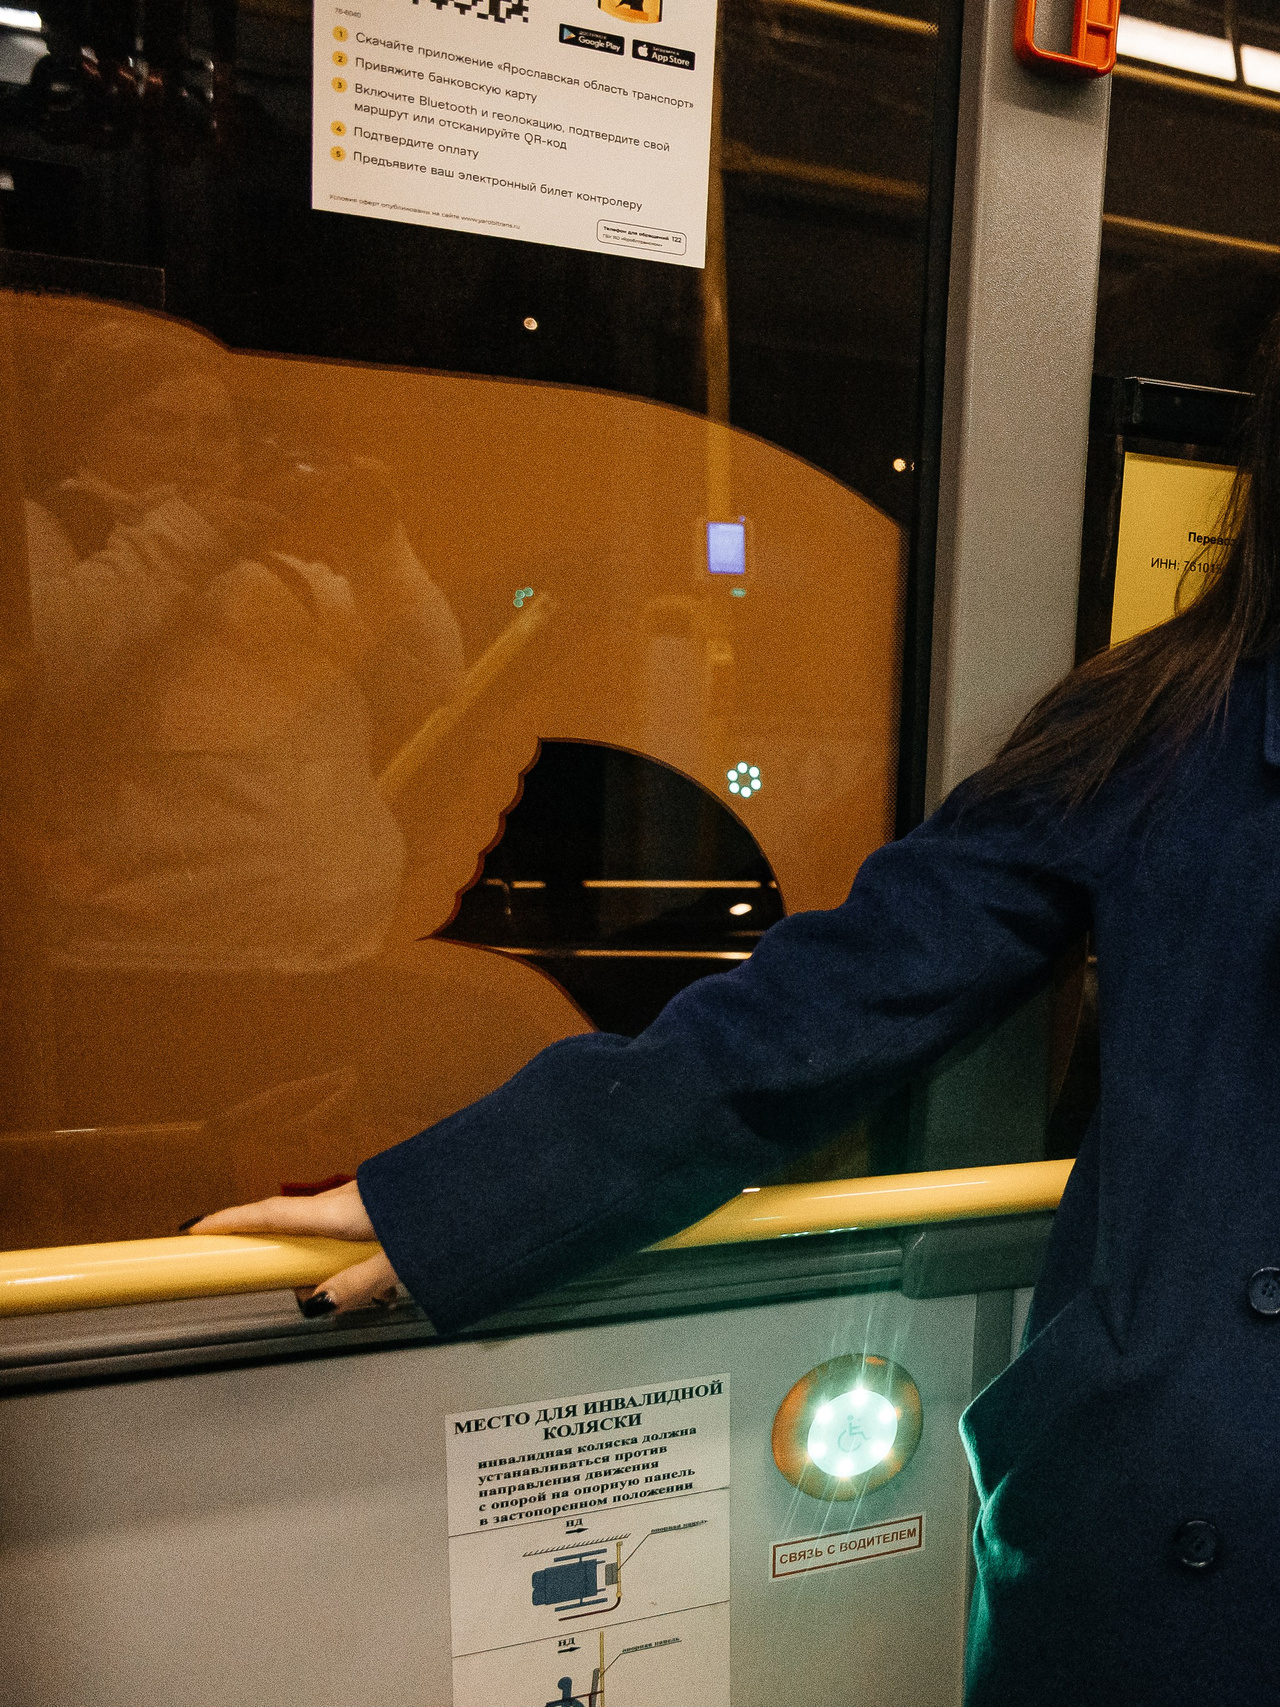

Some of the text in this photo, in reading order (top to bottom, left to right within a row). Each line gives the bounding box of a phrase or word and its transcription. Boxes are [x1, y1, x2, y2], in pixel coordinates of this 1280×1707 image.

[578, 35, 621, 52] Google Play
[652, 52, 690, 67] App Store
[355, 32, 414, 53] Скачайте
[418, 47, 494, 69] приложение
[497, 62, 580, 86] «Ярославская
[584, 80, 628, 96] область
[632, 90, 694, 110] транспорт»
[355, 57, 424, 80] Привяжите
[428, 71, 502, 96] банковскую
[506, 88, 538, 104] карту
[354, 103, 567, 150] маршрут или отсканируйте QR-код
[355, 82, 415, 104] Включите
[419, 96, 478, 116] Bluetooth
[482, 109, 489, 118] и
[492, 112, 564, 133] геолокацию,
[568, 126, 640, 146] подтвердите
[643, 140, 670, 152] свой
[354, 126, 434, 150] Подтвердите
[438, 144, 479, 160] оплату
[353, 151, 427, 173] Предъявите
[430, 167, 454, 178] ваш
[458, 170, 536, 192] электронный
[540, 184, 573, 198] билет
[576, 192, 643, 212] контролеру
[672, 236, 682, 244] 122
[1150, 557, 1180, 570] ИНН:
[454, 1380, 724, 1435] МЕСТО ДЛЯ ИНВАЛИДНОЙ
[543, 1413, 642, 1441] КОЛЯСКИ
[478, 1426, 697, 1469] инвалидная коляска должна
[478, 1444, 668, 1485] устанавливаться против
[478, 1460, 660, 1498] направления движения
[478, 1468, 696, 1512] с опорой на опорную панель
[479, 1482, 694, 1526] в застопоренном положении
[779, 1527, 917, 1564] СВЯЗЬ С ВОДИТЕЛЕМ
